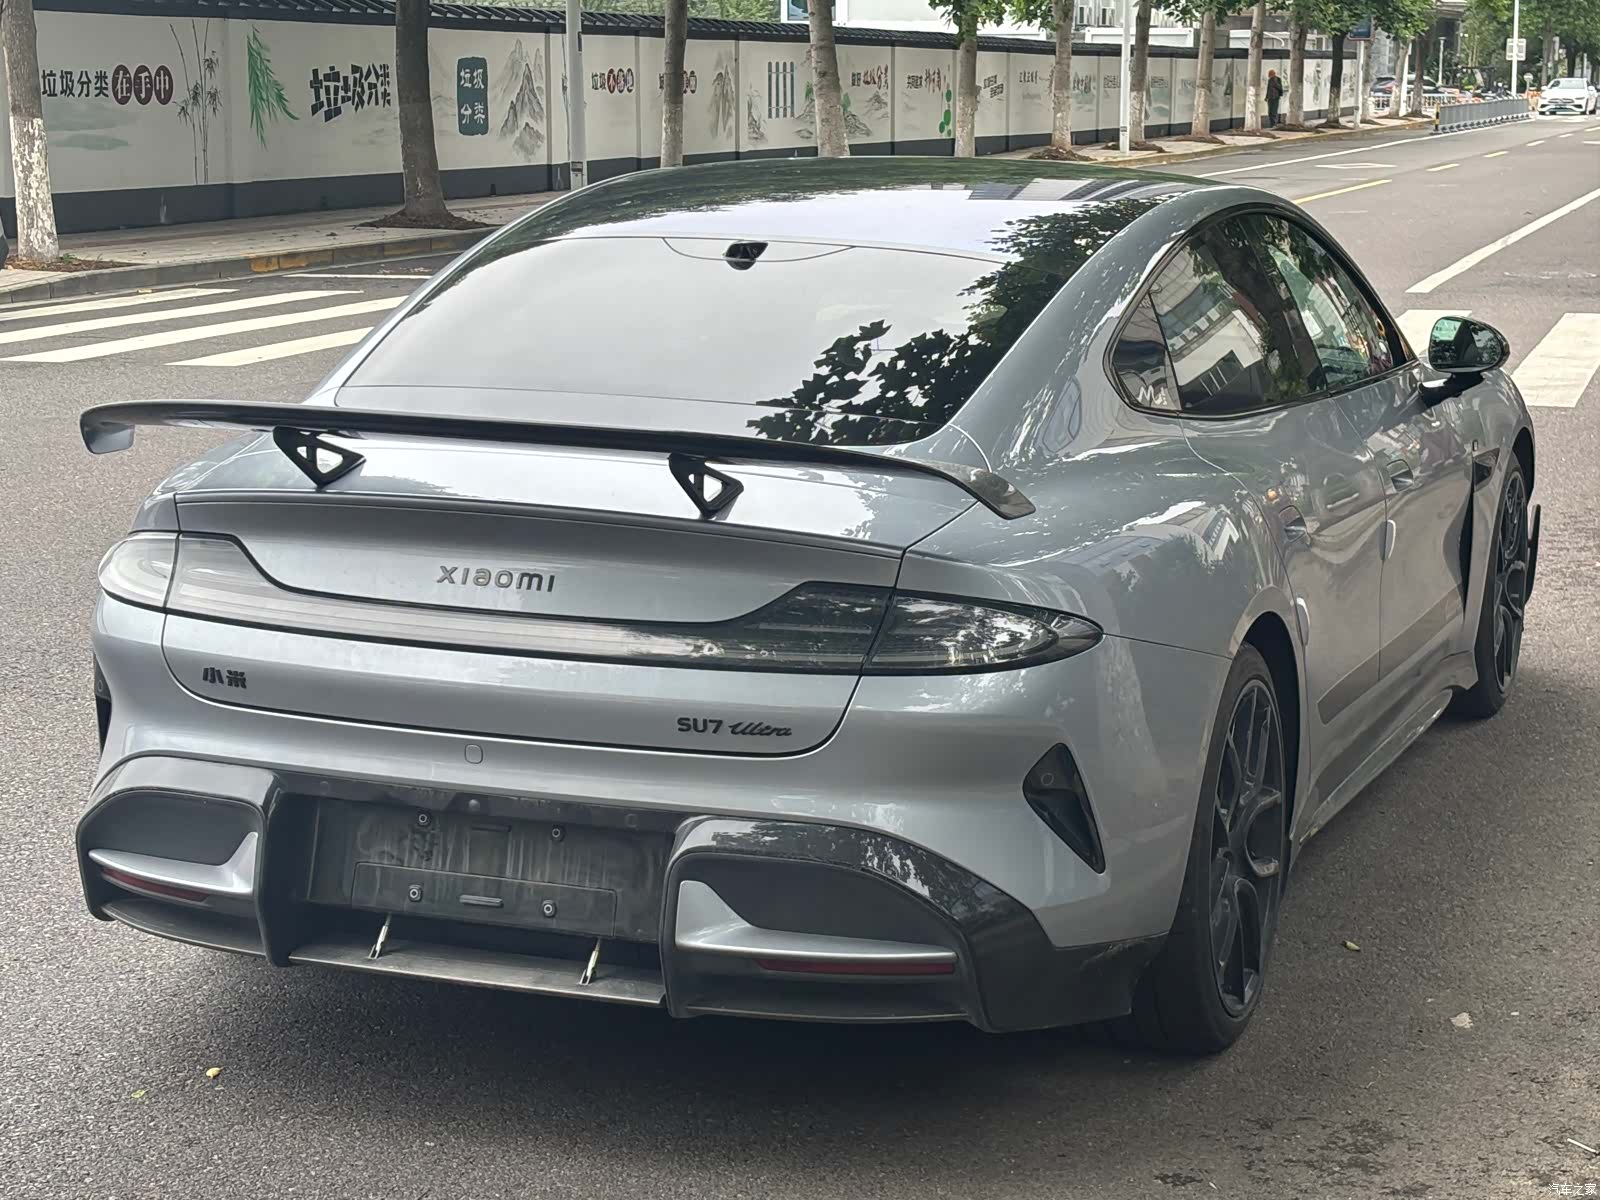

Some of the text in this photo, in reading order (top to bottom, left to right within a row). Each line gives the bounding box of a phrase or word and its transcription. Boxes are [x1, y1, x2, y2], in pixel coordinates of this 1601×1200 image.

[41, 64, 174, 105] 垃圾分类在手中
[460, 67, 485, 89] 垃圾
[309, 63, 392, 122] 垃圾分类
[460, 102, 485, 125] 分类
[202, 666, 247, 689] 小米
[677, 717, 792, 736] SU7 Ultra
